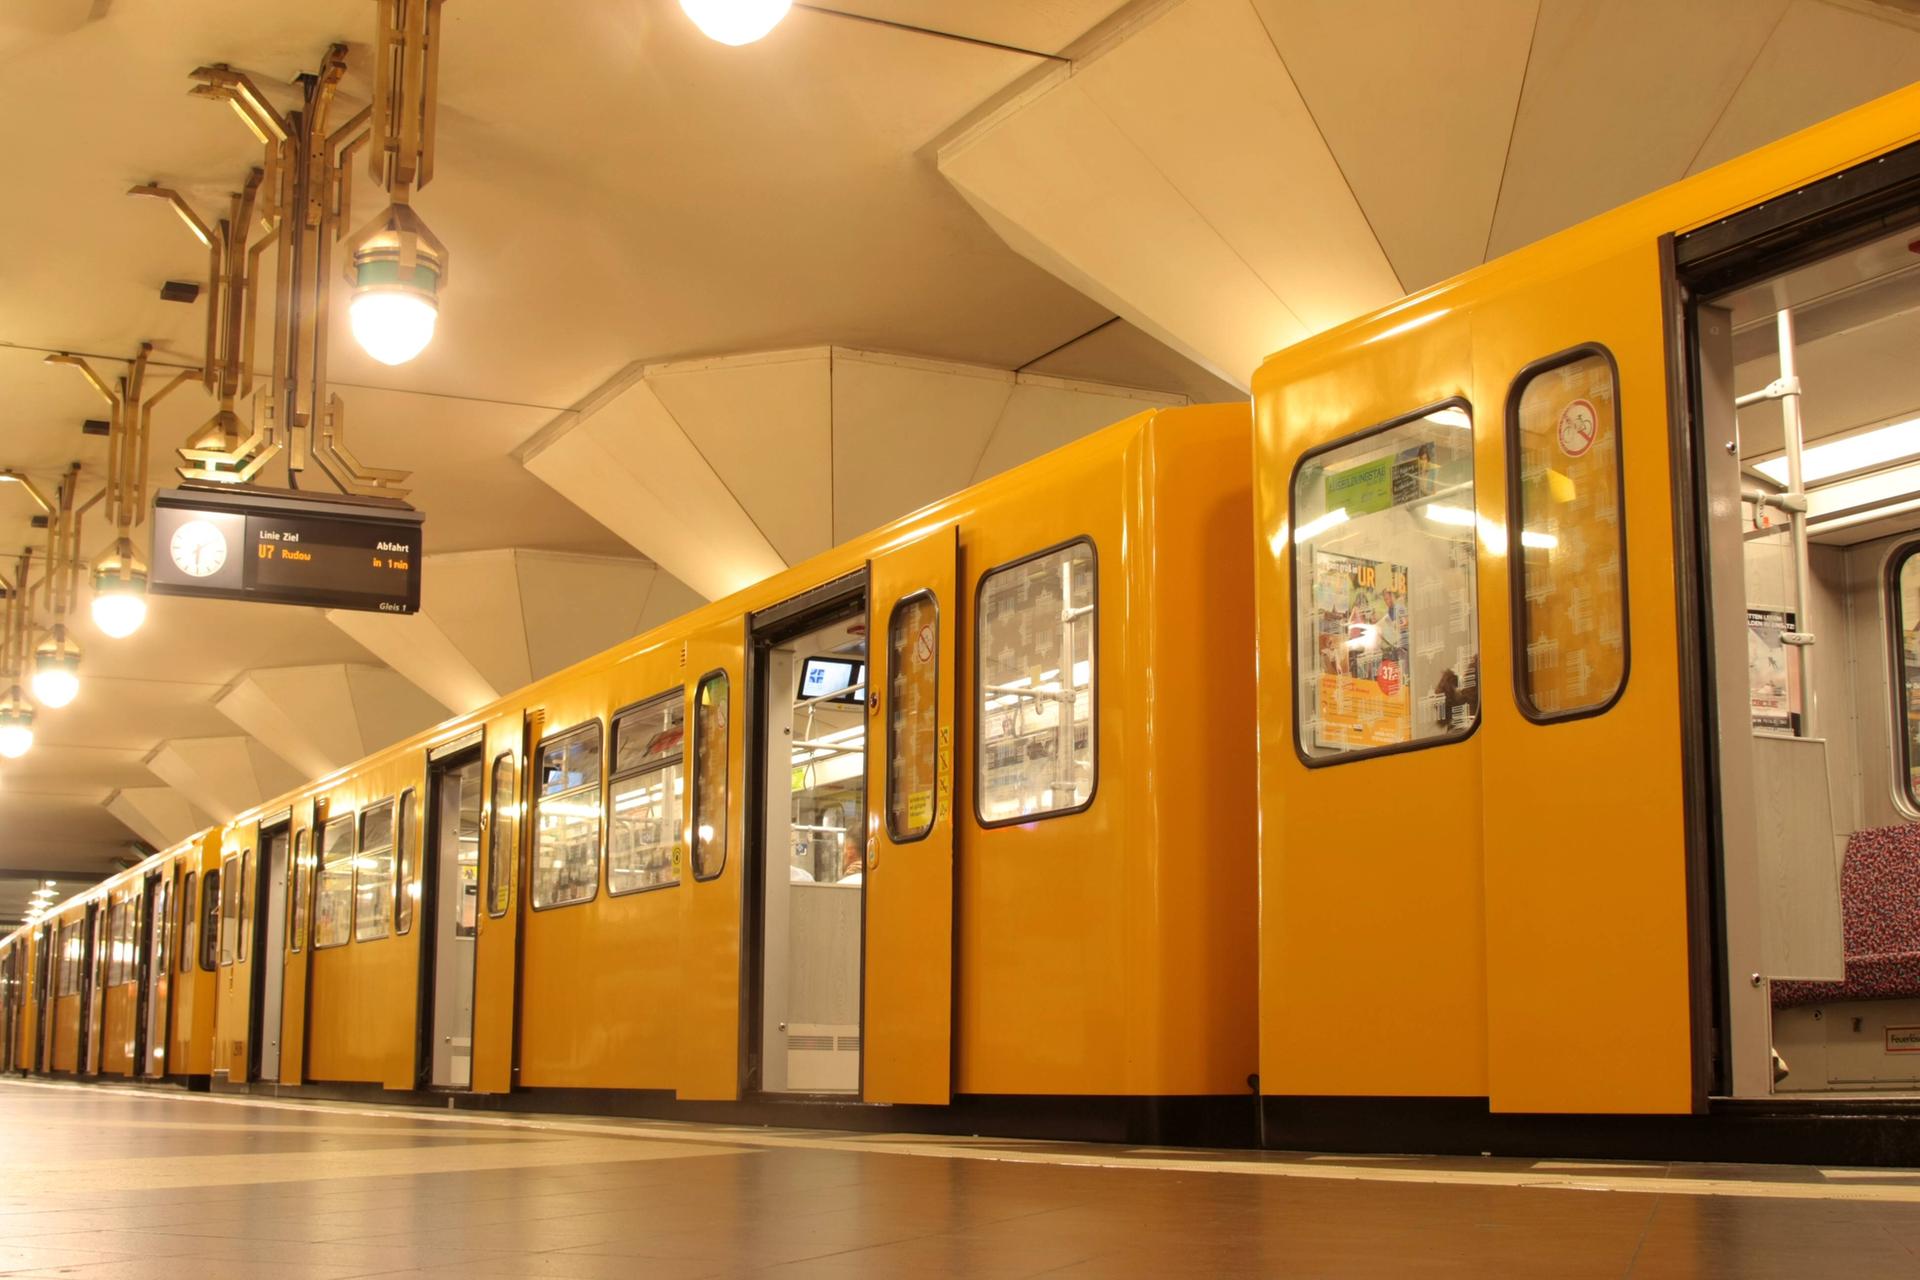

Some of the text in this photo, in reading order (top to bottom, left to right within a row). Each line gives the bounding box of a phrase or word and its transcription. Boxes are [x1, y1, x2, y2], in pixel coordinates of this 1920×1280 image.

[259, 530, 299, 543] Linie Ziel
[258, 543, 311, 561] U7 Rudow
[376, 541, 409, 553] Abfahrt
[373, 557, 382, 568] in
[379, 602, 407, 612] Gleis 1
